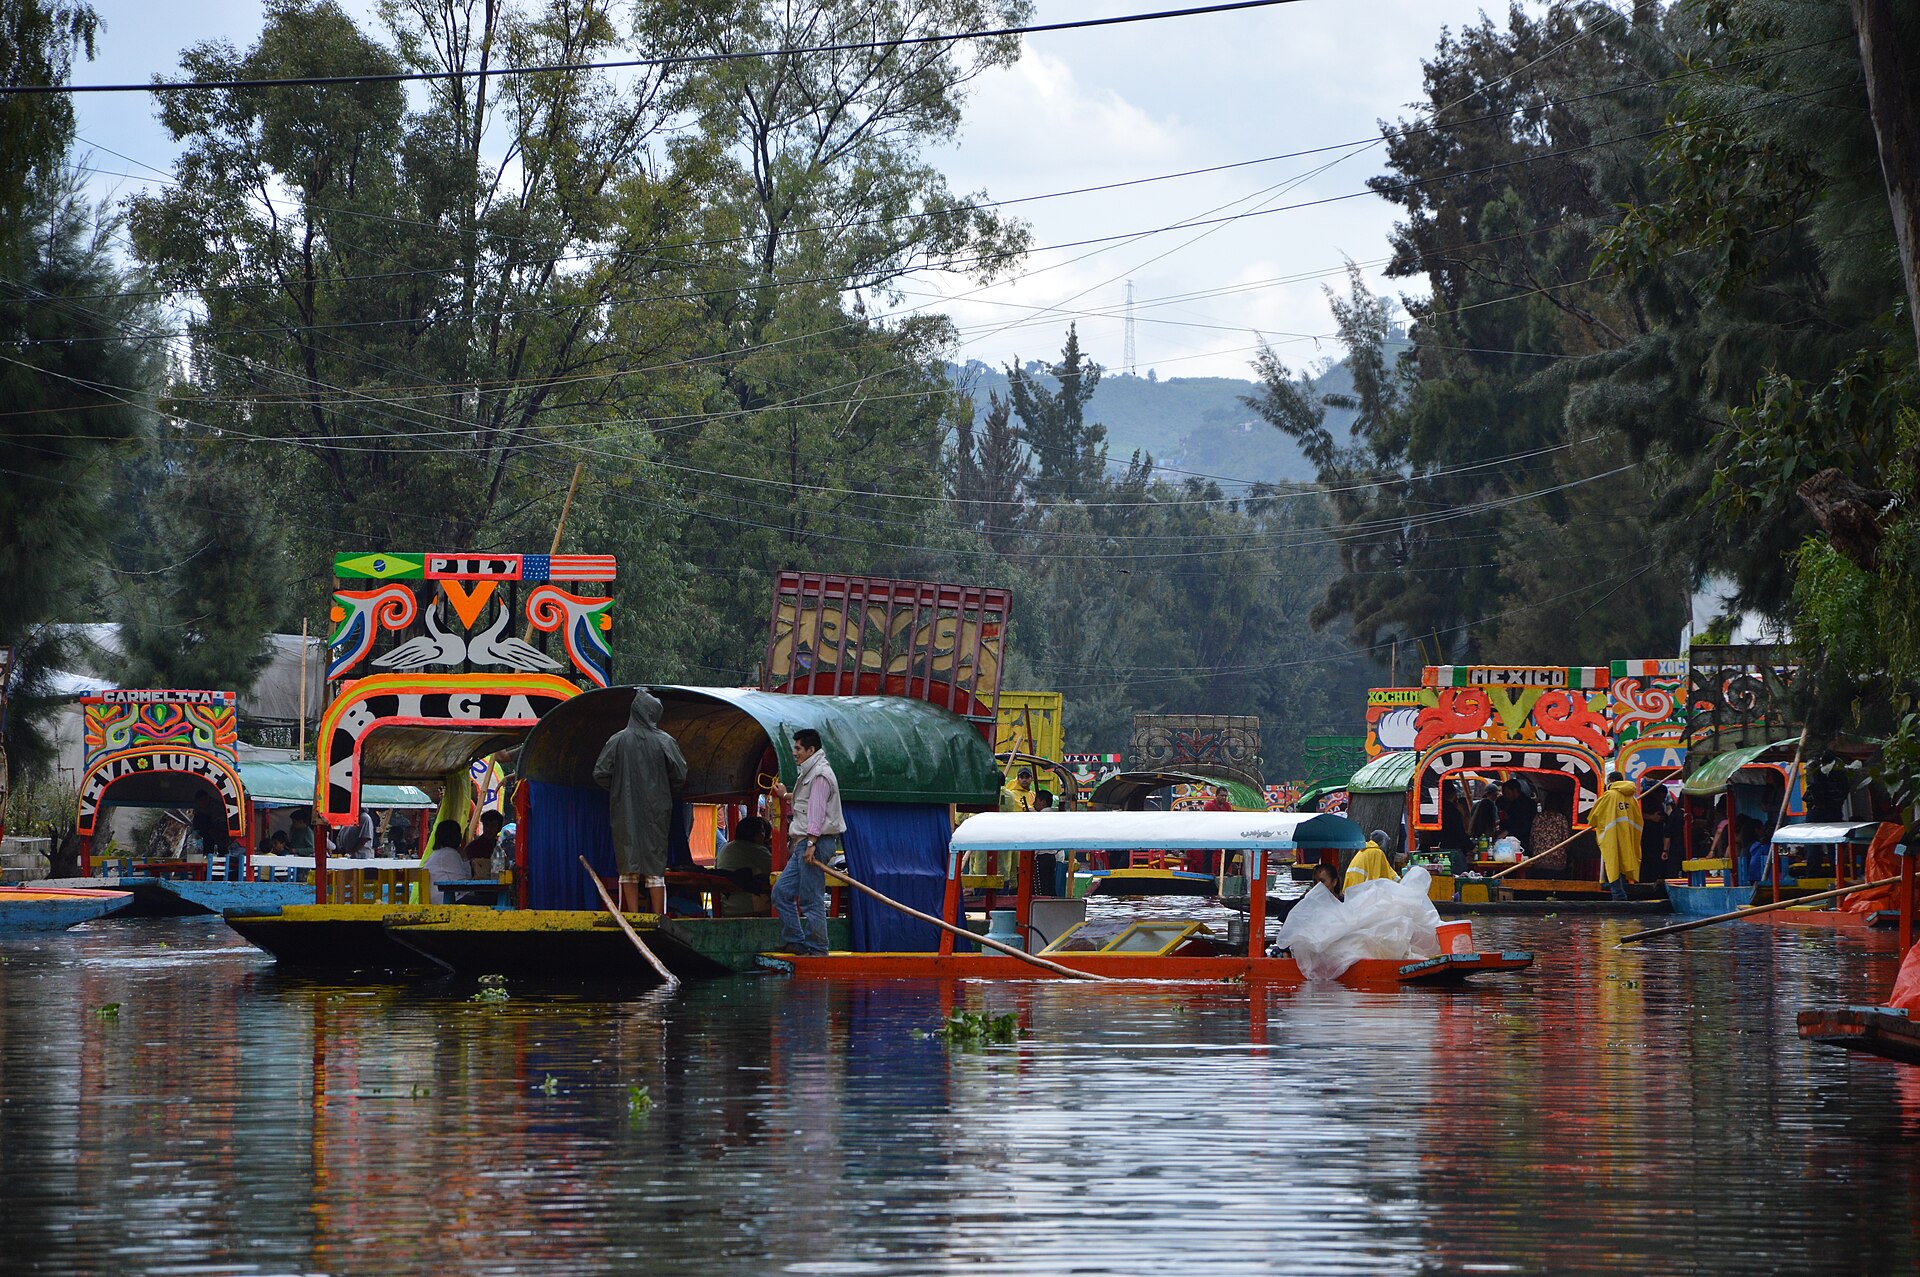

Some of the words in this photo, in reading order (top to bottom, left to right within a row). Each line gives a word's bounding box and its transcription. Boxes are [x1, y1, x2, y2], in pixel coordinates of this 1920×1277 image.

[431, 559, 517, 574] PILY
[1471, 670, 1564, 685] MEXICO
[103, 691, 212, 703] CARMELITA
[1368, 691, 1420, 703] XOCHIM
[329, 694, 537, 793] ABIGA
[80, 758, 135, 816] VIVA
[152, 754, 238, 818] LUPITA
[1420, 750, 1598, 814] LUPITA
